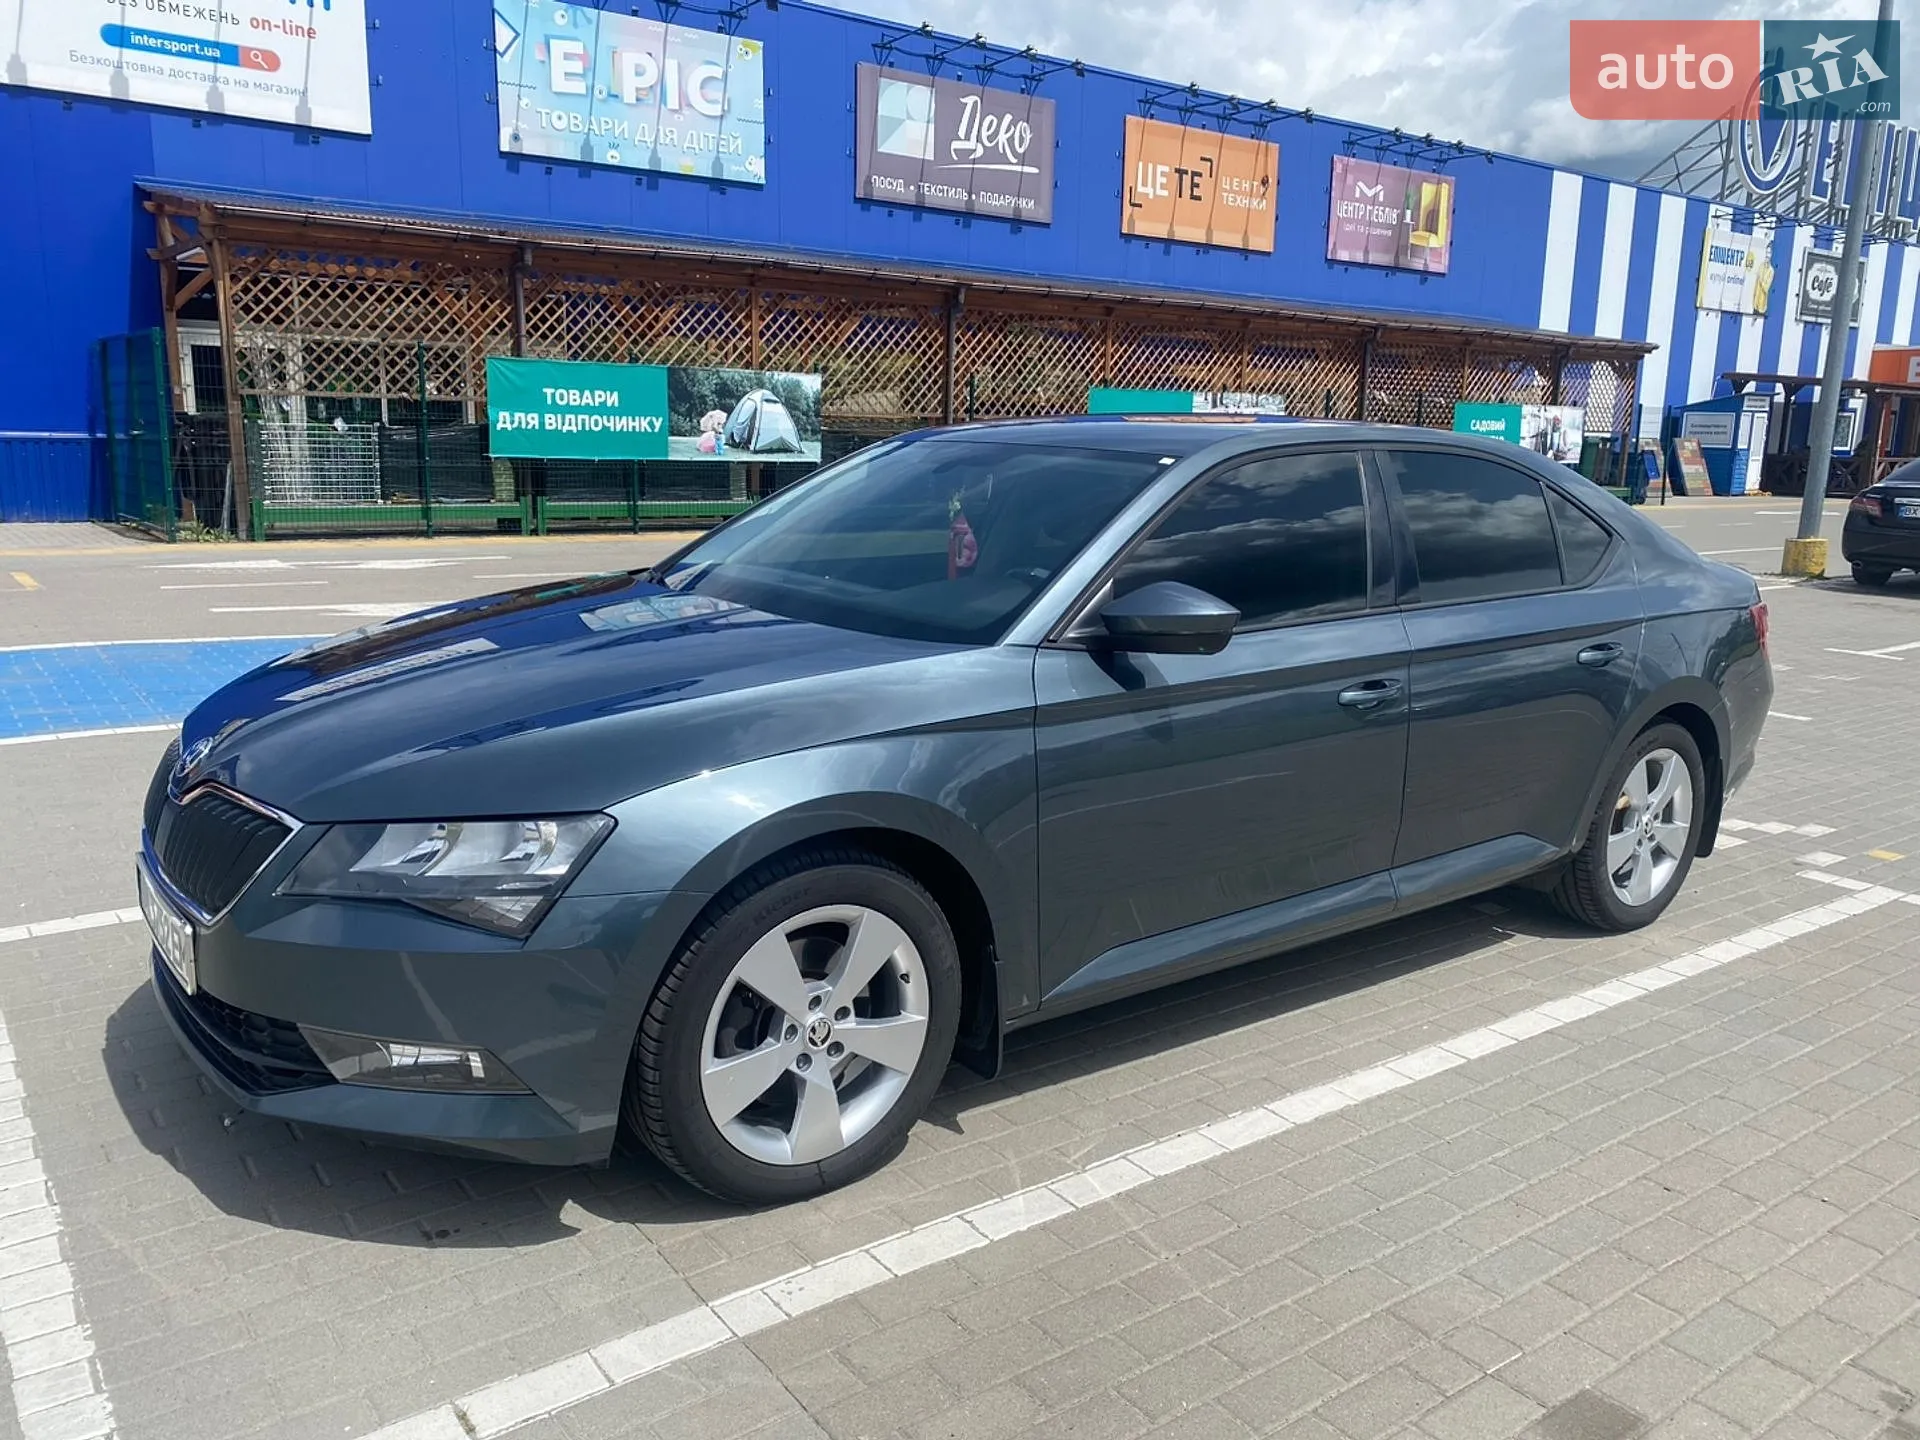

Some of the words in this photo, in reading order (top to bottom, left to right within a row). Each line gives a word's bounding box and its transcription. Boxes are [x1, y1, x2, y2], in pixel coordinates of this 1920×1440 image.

[249, 17, 317, 39] on-line
[130, 32, 221, 58] intersport.ua
[69, 50, 164, 76] Безкоштовна
[168, 67, 230, 86] доставка
[233, 78, 249, 89] на
[537, 108, 629, 139] ТОВАРИ
[634, 123, 678, 148] ДЛЯ
[682, 130, 742, 156] ДІТЕЙ
[950, 95, 1033, 164] Деко
[871, 175, 904, 193] ПОСУД
[918, 182, 968, 201] ТЕКСТИЛЬ
[979, 190, 1035, 210] ПОДАРУНКИ
[1337, 199, 1365, 220] ЦЕНТР
[543, 387, 619, 408] ТОВАРИ
[496, 411, 539, 431] ДЛЯ
[544, 413, 663, 433] ВІДПОЧИНКУ
